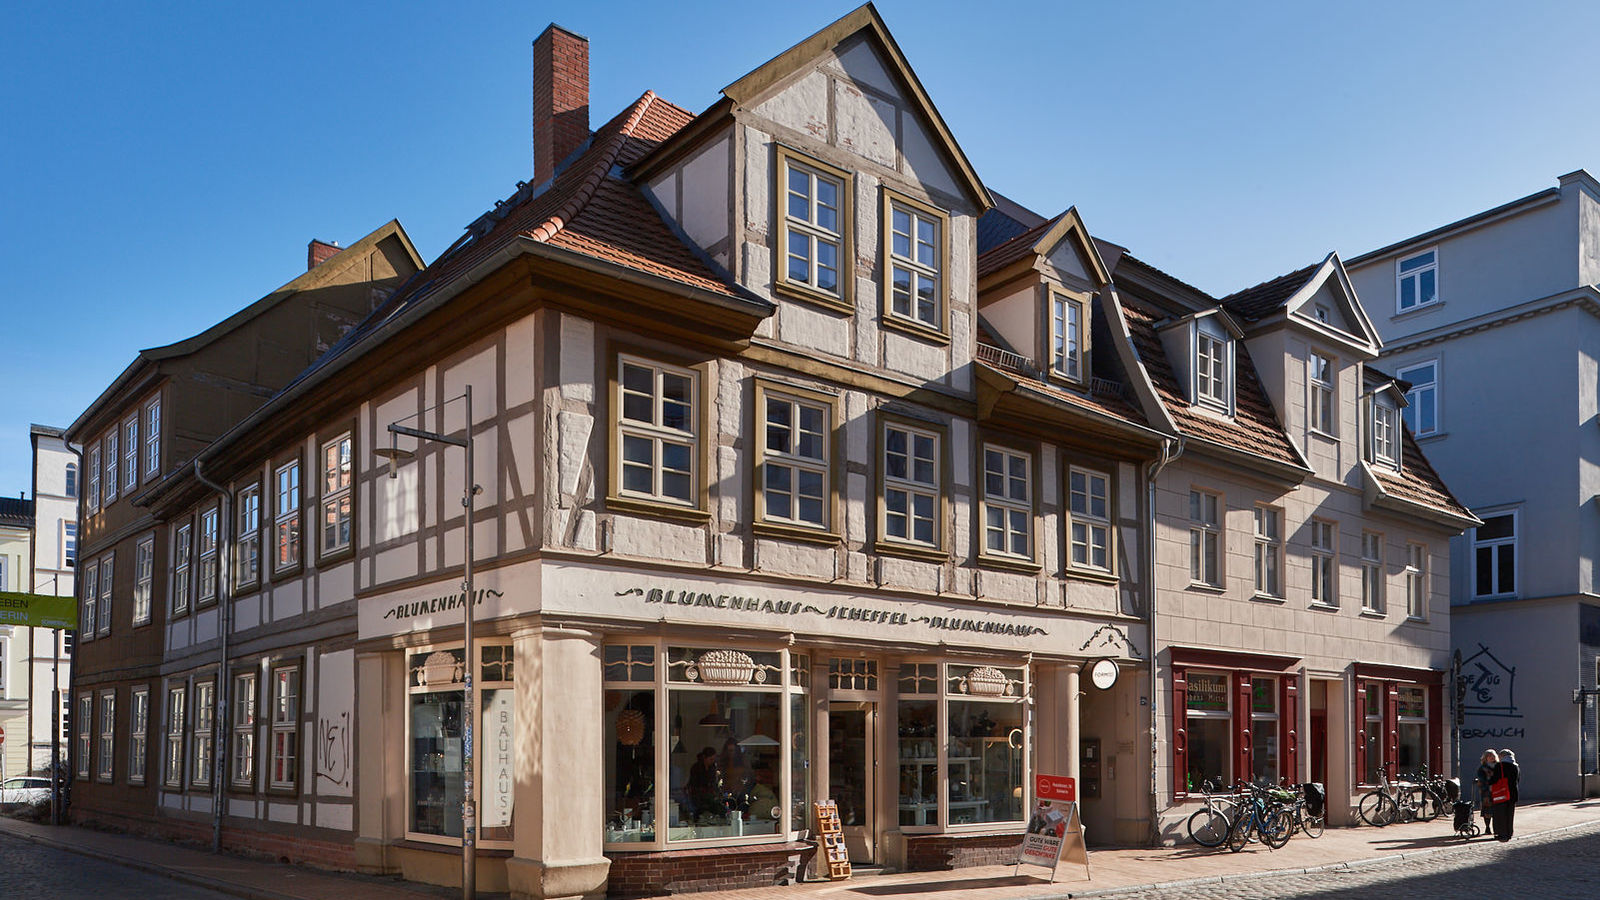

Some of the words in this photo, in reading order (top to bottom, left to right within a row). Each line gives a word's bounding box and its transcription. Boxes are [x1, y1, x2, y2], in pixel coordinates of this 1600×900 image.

[645, 588, 802, 614] BLUMENHAUS
[826, 605, 908, 625] SCHEFFEL
[929, 616, 1034, 637] BLUMENHAUS
[1187, 679, 1226, 693] asilikum
[498, 711, 510, 808] BAUHAUS
[1029, 836, 1044, 844] GUTE
[1044, 838, 1060, 847] WARE
